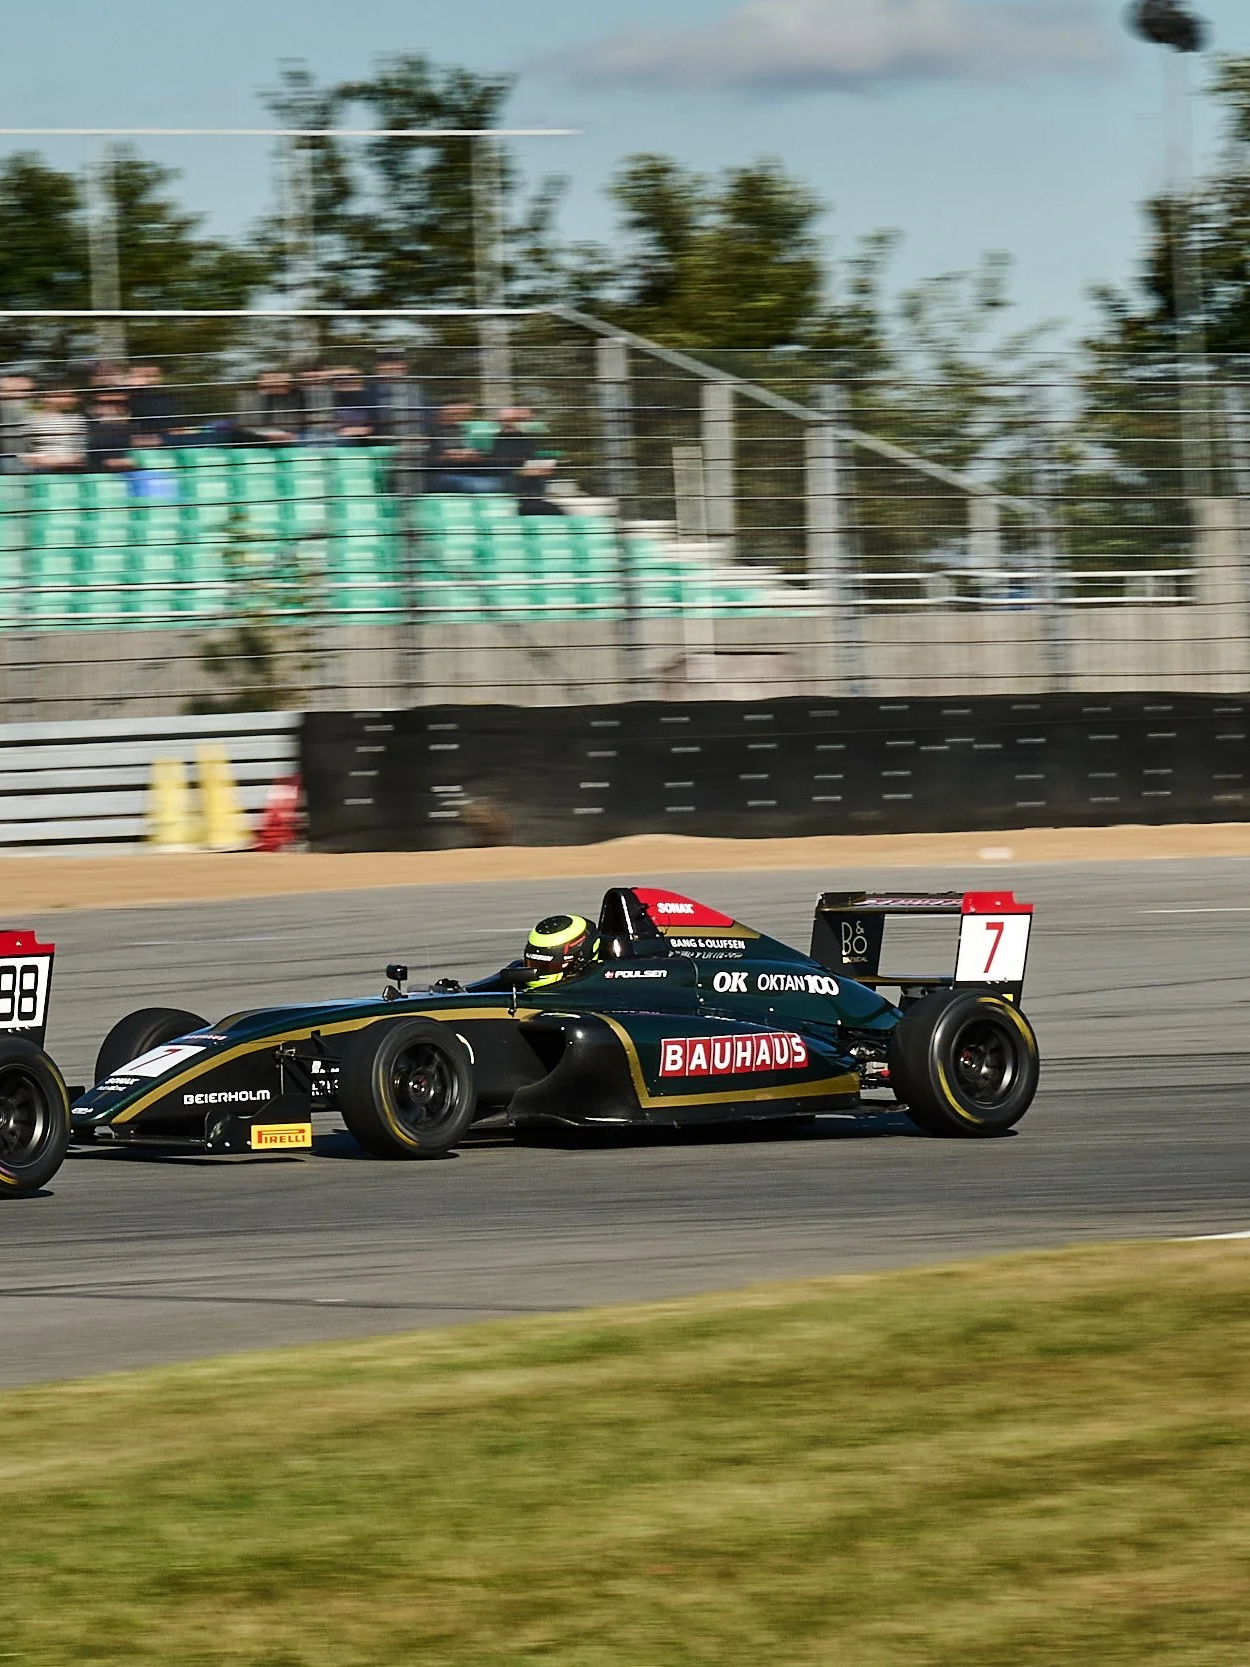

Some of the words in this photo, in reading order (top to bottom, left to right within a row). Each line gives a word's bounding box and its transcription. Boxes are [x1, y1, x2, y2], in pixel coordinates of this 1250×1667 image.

[657, 902, 694, 914] SONAX
[670, 938, 697, 948] BANG
[698, 938, 706, 948] &
[705, 939, 746, 950] OLUFSEN
[983, 921, 1005, 974] 7
[615, 969, 668, 979] POULSEN
[713, 971, 749, 993] OK
[129, 1048, 183, 1072] 7
[665, 1036, 807, 1072] BAUHAUS
[183, 1089, 271, 1105] BEIERHOLM
[256, 1128, 307, 1145] PIRELLI
